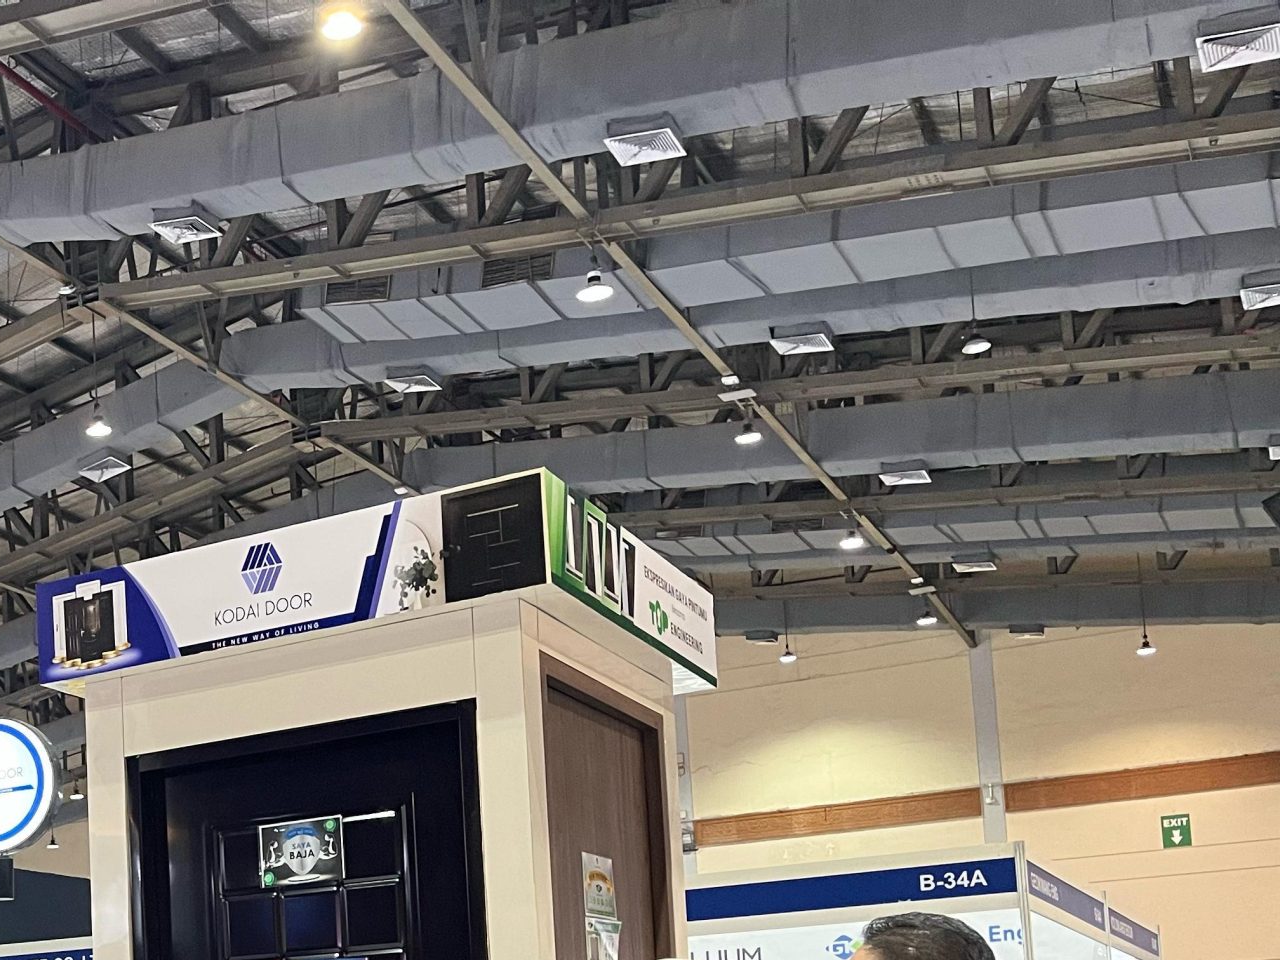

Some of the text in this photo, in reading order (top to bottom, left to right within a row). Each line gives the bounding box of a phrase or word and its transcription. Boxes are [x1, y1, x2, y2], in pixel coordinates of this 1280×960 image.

[214, 592, 313, 627] KODAI DOOR
[648, 600, 669, 636] TOP
[211, 622, 320, 649] THE NEW WAY OF LIVING
[670, 622, 704, 655] ENGINEERING
[1163, 817, 1188, 828] EXIT
[289, 849, 315, 860] BAJA
[292, 841, 312, 849] SAYA
[919, 869, 988, 892] B-34A
